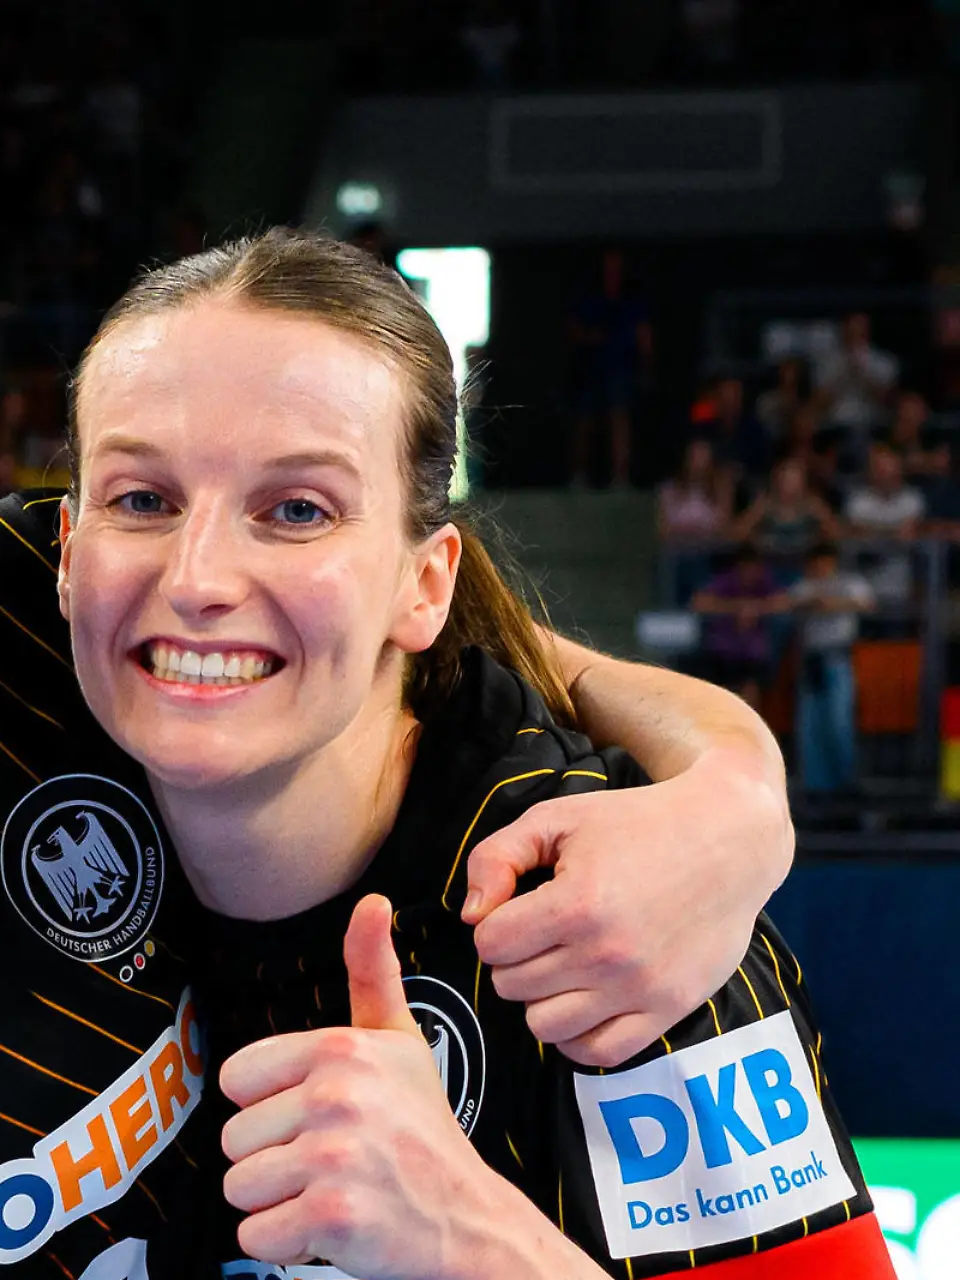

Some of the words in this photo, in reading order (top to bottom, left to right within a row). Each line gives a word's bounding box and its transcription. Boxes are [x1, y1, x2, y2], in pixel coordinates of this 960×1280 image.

[46, 926, 113, 953] DEUTSCHER
[113, 846, 157, 946] HANDBALLBUND
[598, 1048, 809, 1185] DKB
[627, 1200, 690, 1229] Das
[695, 1182, 769, 1218] kann
[769, 1151, 828, 1195] Bank
